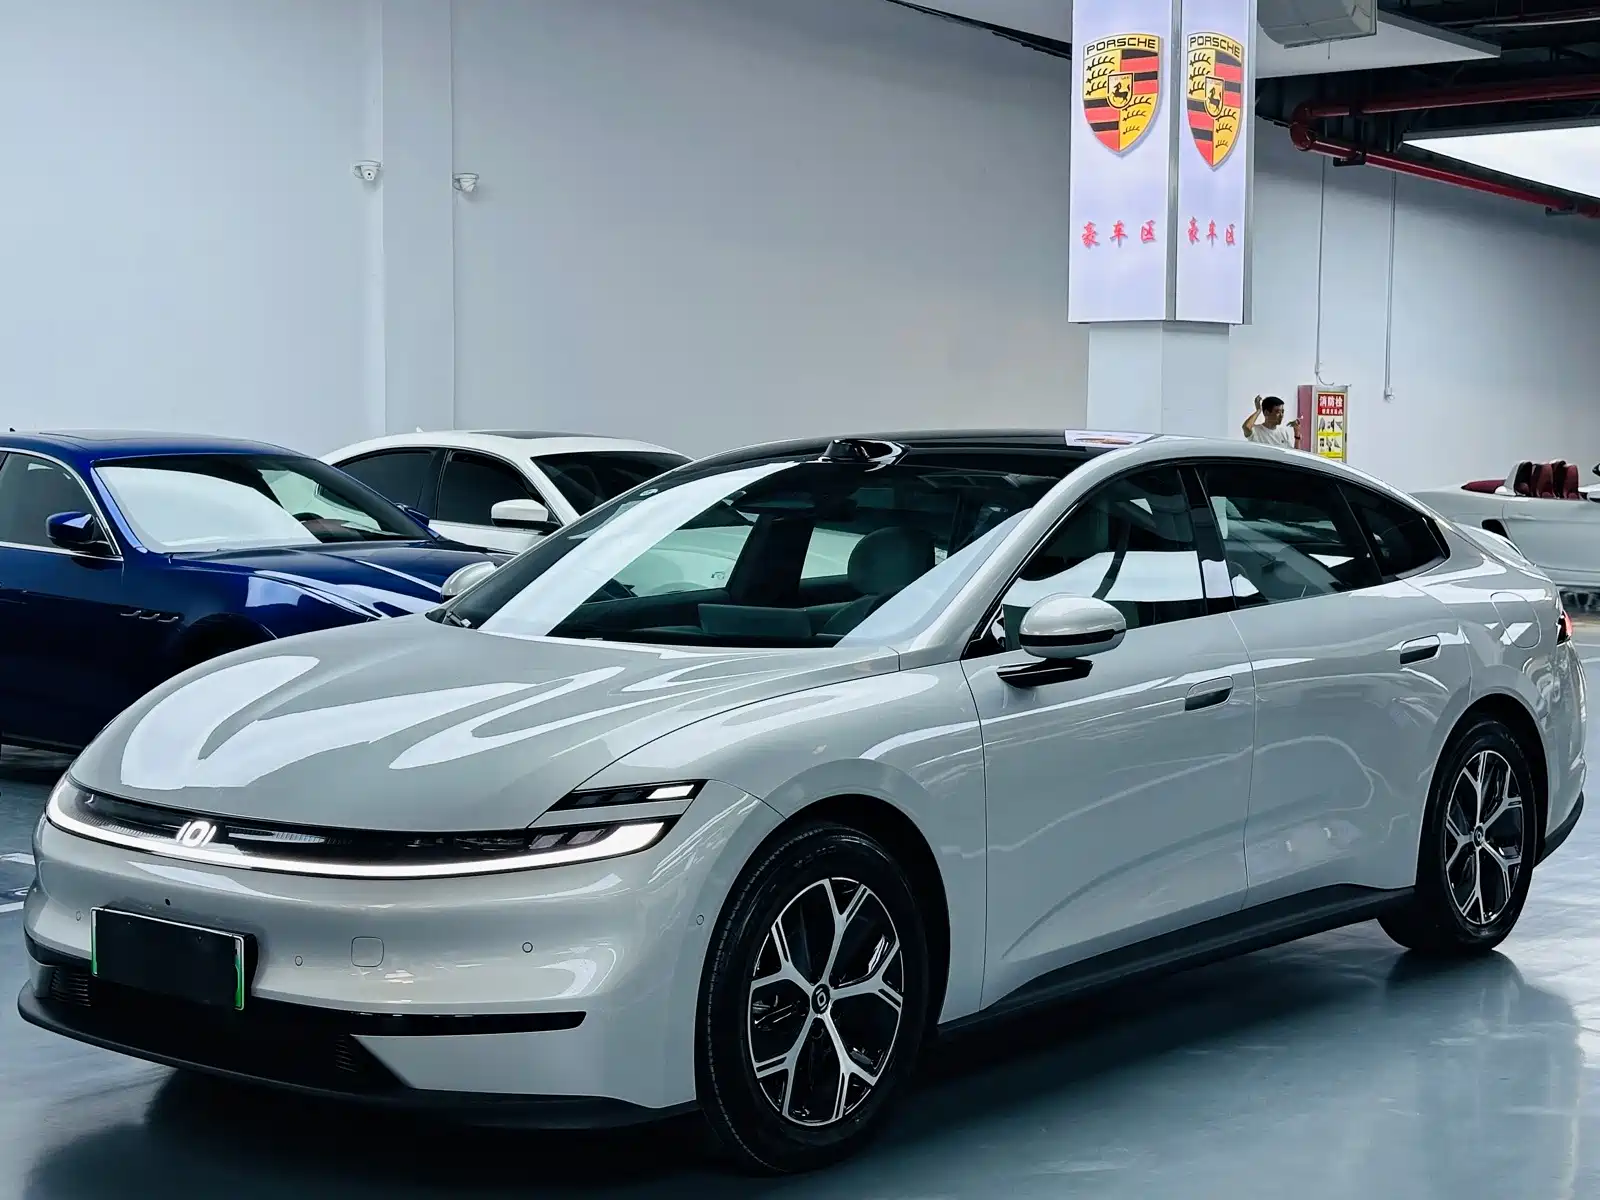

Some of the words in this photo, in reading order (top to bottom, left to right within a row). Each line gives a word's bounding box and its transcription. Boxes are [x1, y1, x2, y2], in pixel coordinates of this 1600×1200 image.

[1086, 37, 1156, 55] PORSCHE
[1189, 35, 1241, 58] PORSCHE
[1082, 220, 1156, 248] 豪车区
[1187, 217, 1235, 246] 豪车区
[1319, 395, 1343, 408] 消防栓
